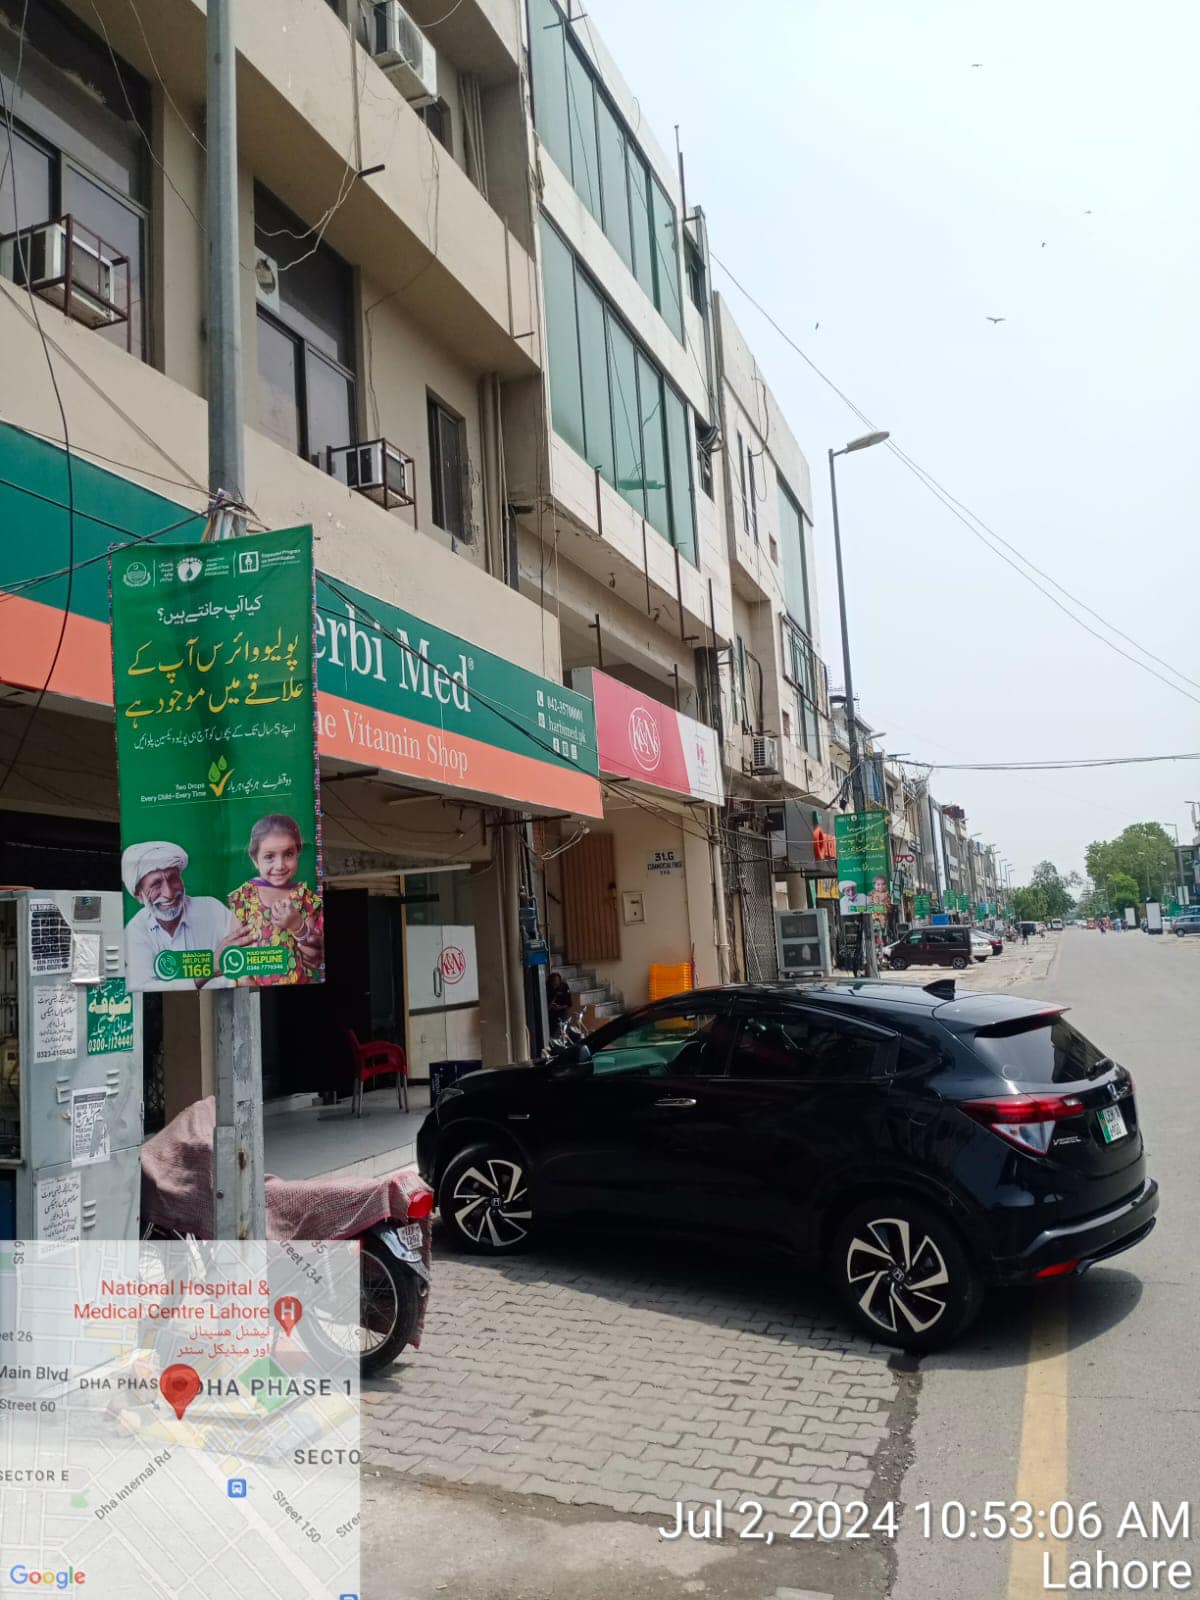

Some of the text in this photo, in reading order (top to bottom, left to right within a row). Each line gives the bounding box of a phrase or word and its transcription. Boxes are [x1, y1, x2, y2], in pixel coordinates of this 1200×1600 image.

[185, 601, 223, 623] جانتے
[224, 595, 244, 621] آپ
[244, 595, 263, 616] کیا
[127, 627, 299, 684] پولیو وائرس آپ کے
[124, 673, 304, 729] علاقے میں موجود ہے
[342, 708, 421, 761] Vitamin
[427, 733, 469, 779] Shop
[182, 964, 212, 977] 1166
[246, 955, 282, 964] HELPLINE
